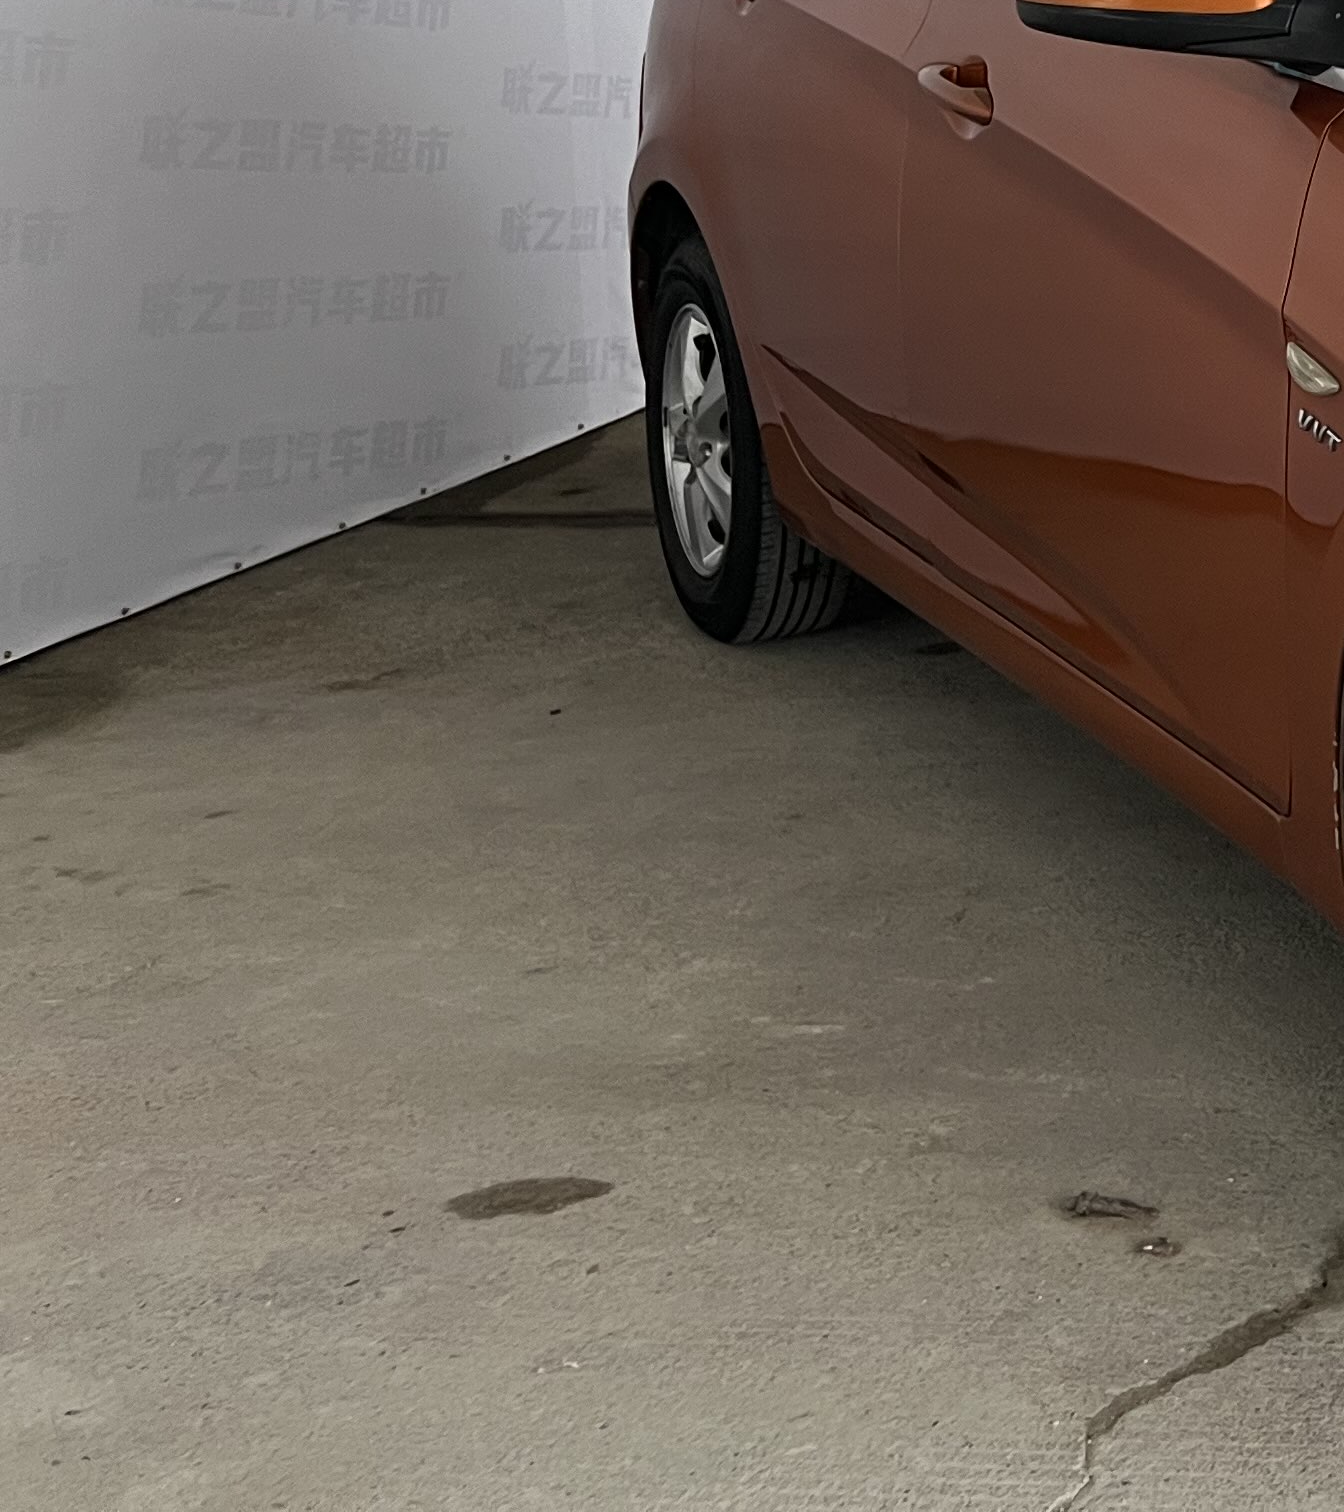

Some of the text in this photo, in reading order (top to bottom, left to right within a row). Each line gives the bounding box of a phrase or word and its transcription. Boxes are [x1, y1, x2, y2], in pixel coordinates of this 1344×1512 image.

[139, 104, 452, 175] 联之盟汽车超市
[138, 270, 451, 338] 联之盟汽车超市
